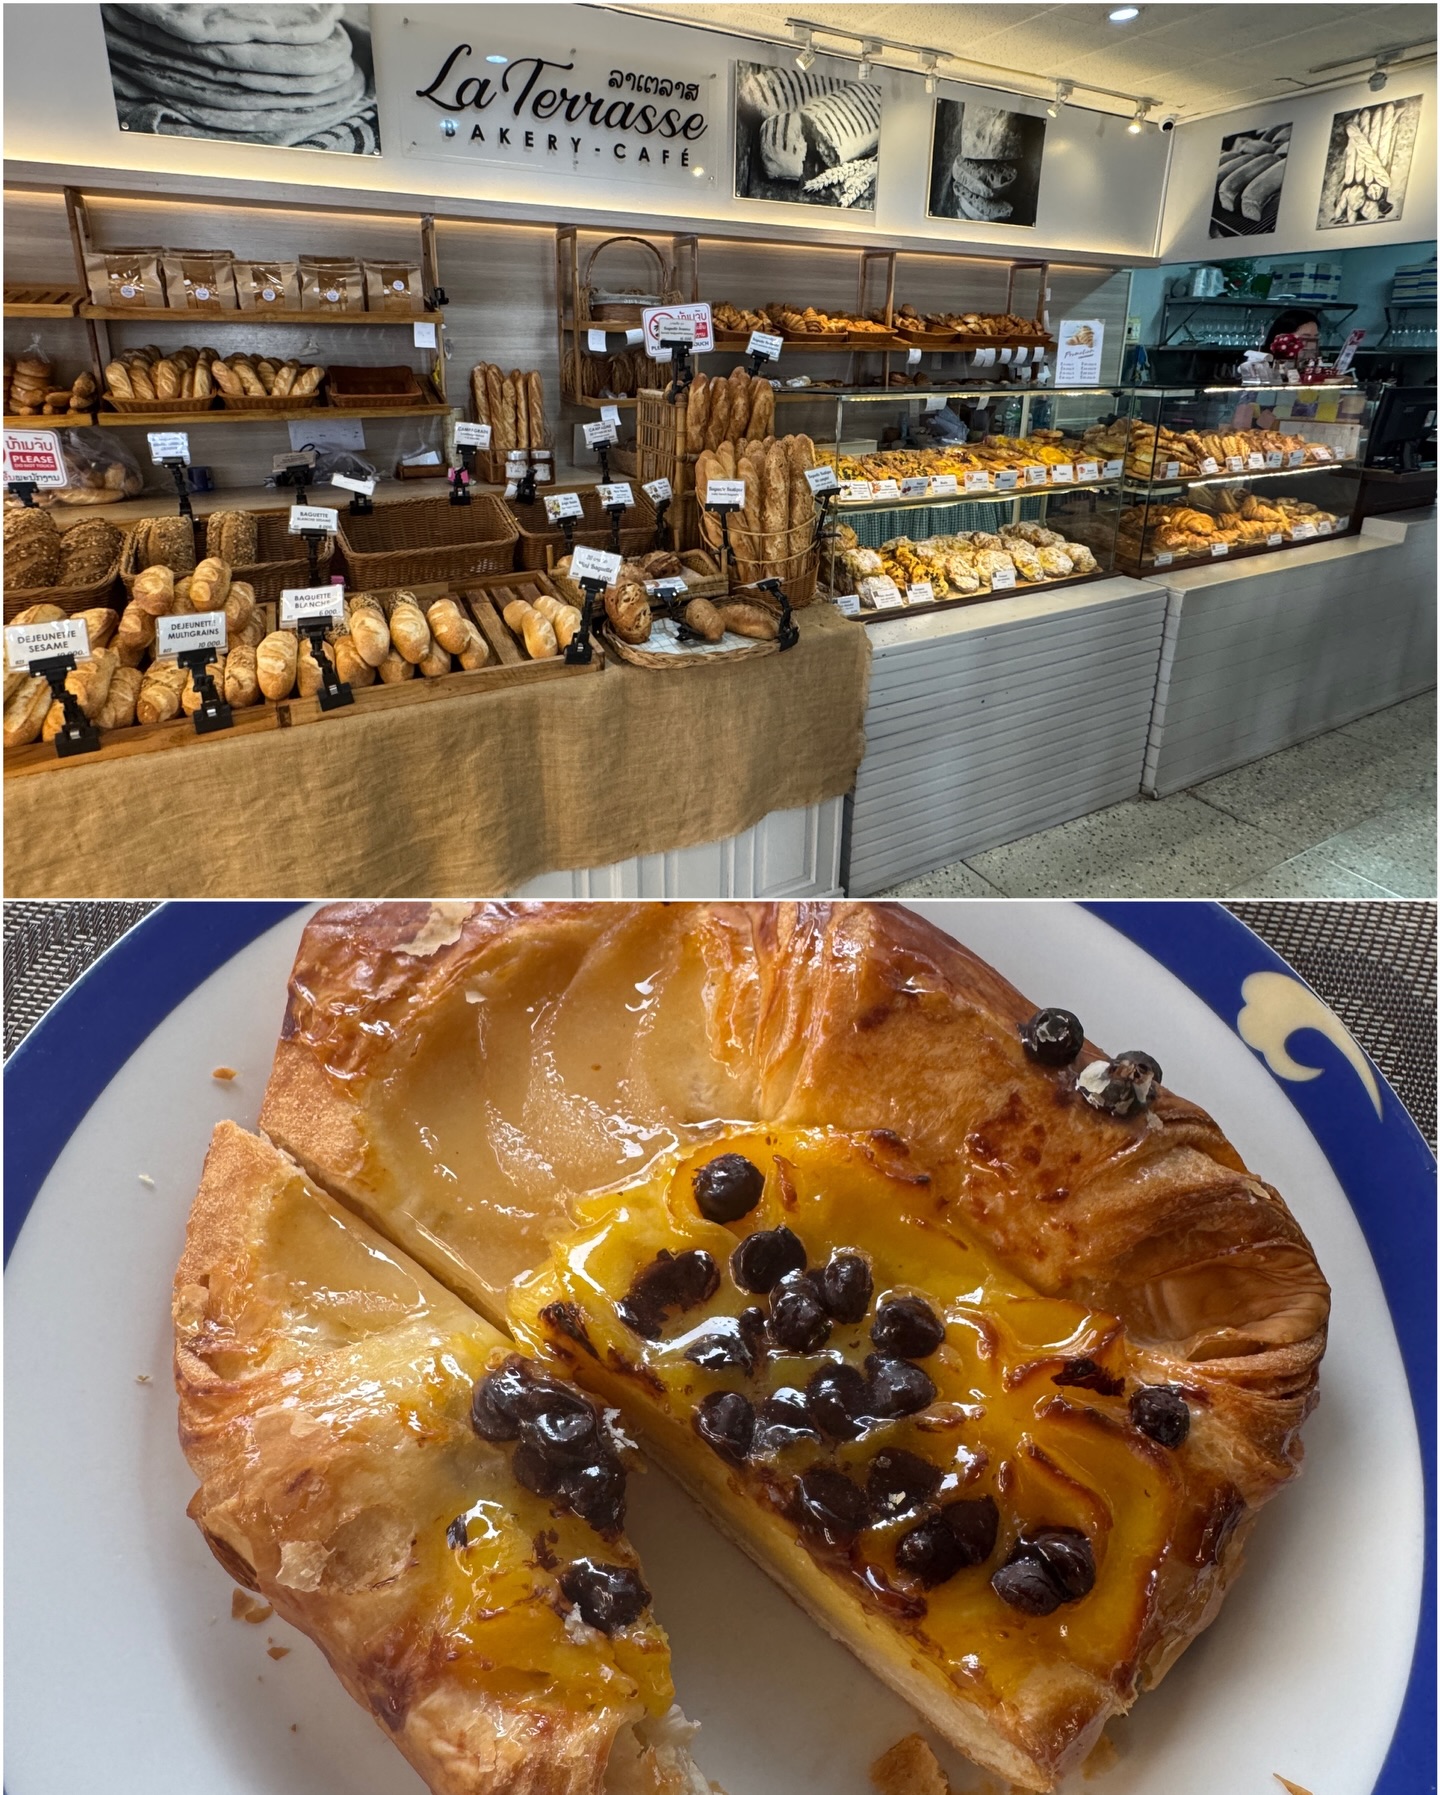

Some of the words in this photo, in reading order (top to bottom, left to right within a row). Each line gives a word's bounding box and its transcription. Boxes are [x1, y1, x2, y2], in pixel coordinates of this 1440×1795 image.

[416, 44, 497, 111] La
[502, 58, 708, 140] Terrasse
[12, 455, 55, 464] PLEASE
[294, 592, 331, 602] BAGUETTE
[17, 629, 76, 644] DEJEUNETTE
[168, 628, 220, 640] MULTIGRAINS
[28, 640, 69, 653] SESAME
